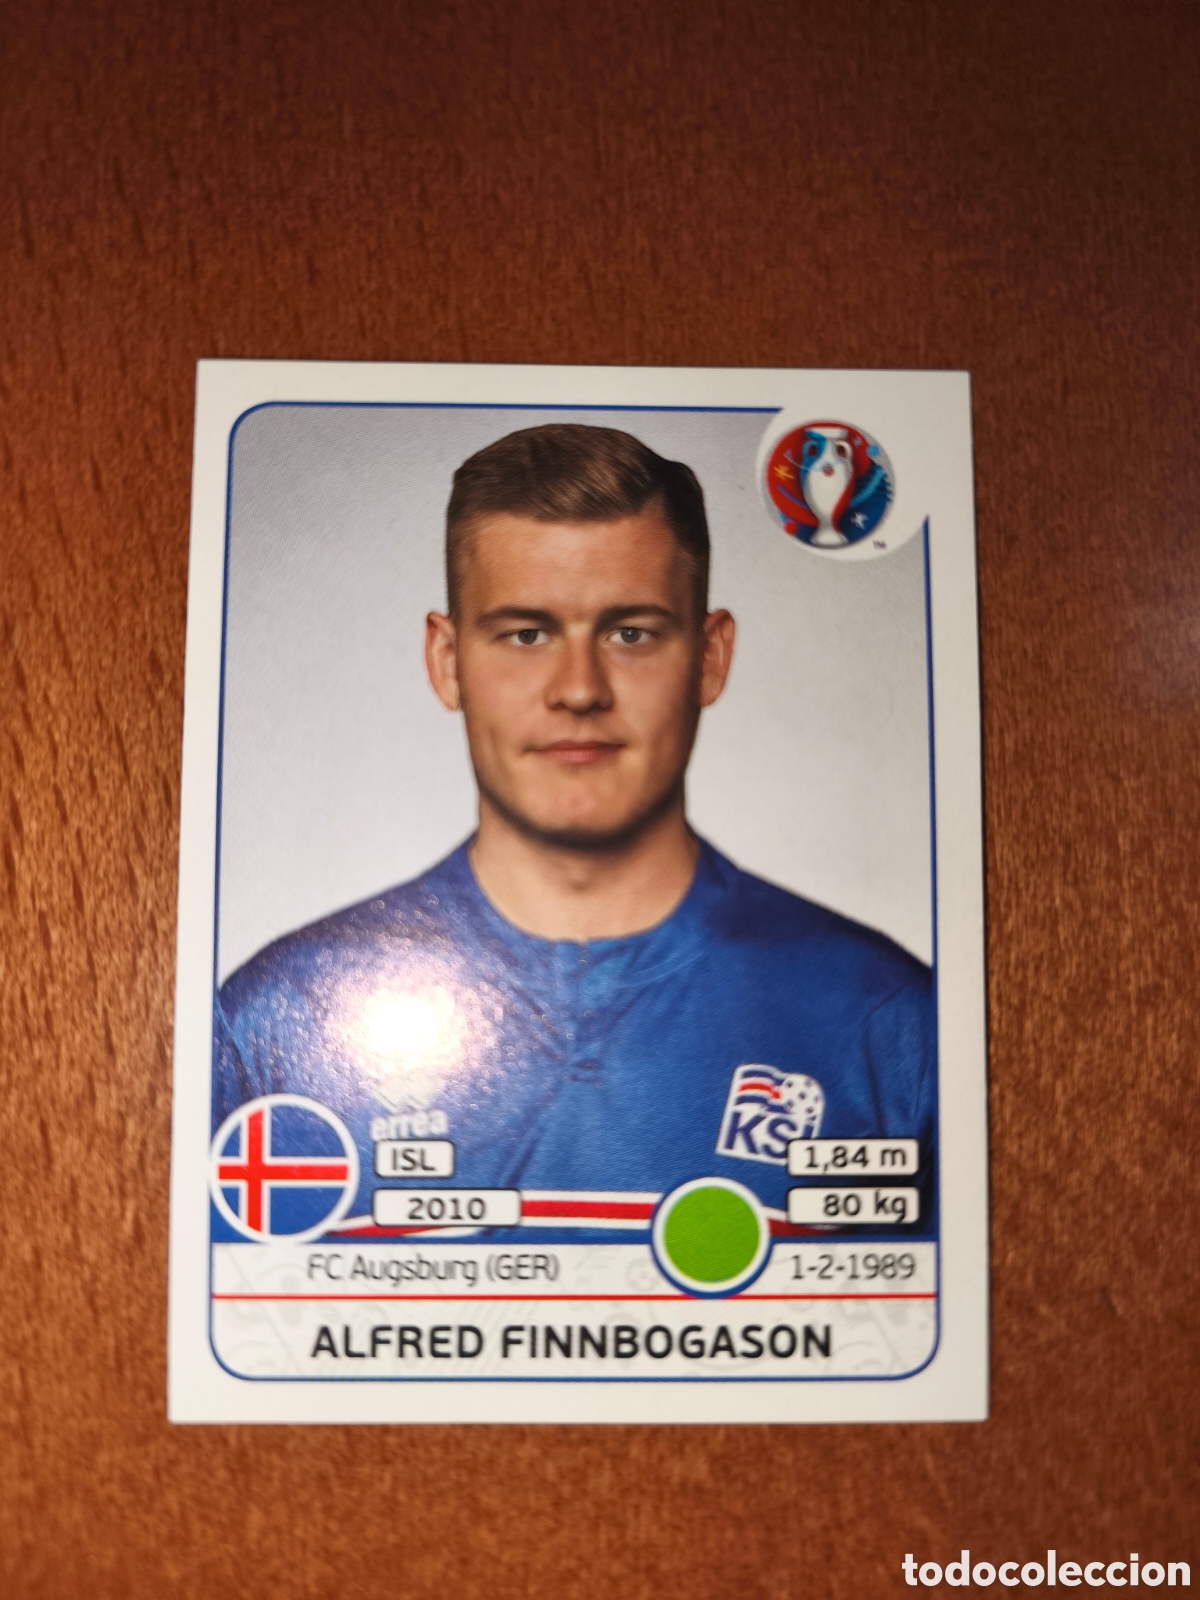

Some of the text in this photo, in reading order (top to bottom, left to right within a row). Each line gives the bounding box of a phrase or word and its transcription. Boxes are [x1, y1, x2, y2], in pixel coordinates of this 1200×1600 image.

[391, 1148, 436, 1171] ISL
[805, 1146, 907, 1173] 1,84 m
[407, 1198, 486, 1220] 2010
[823, 1190, 907, 1222] 80 kg
[308, 1253, 559, 1287] FC Augsburg (GER)
[791, 1254, 915, 1280] 1-2-1989
[311, 1325, 832, 1358] ALFRED FINNBOGASON
